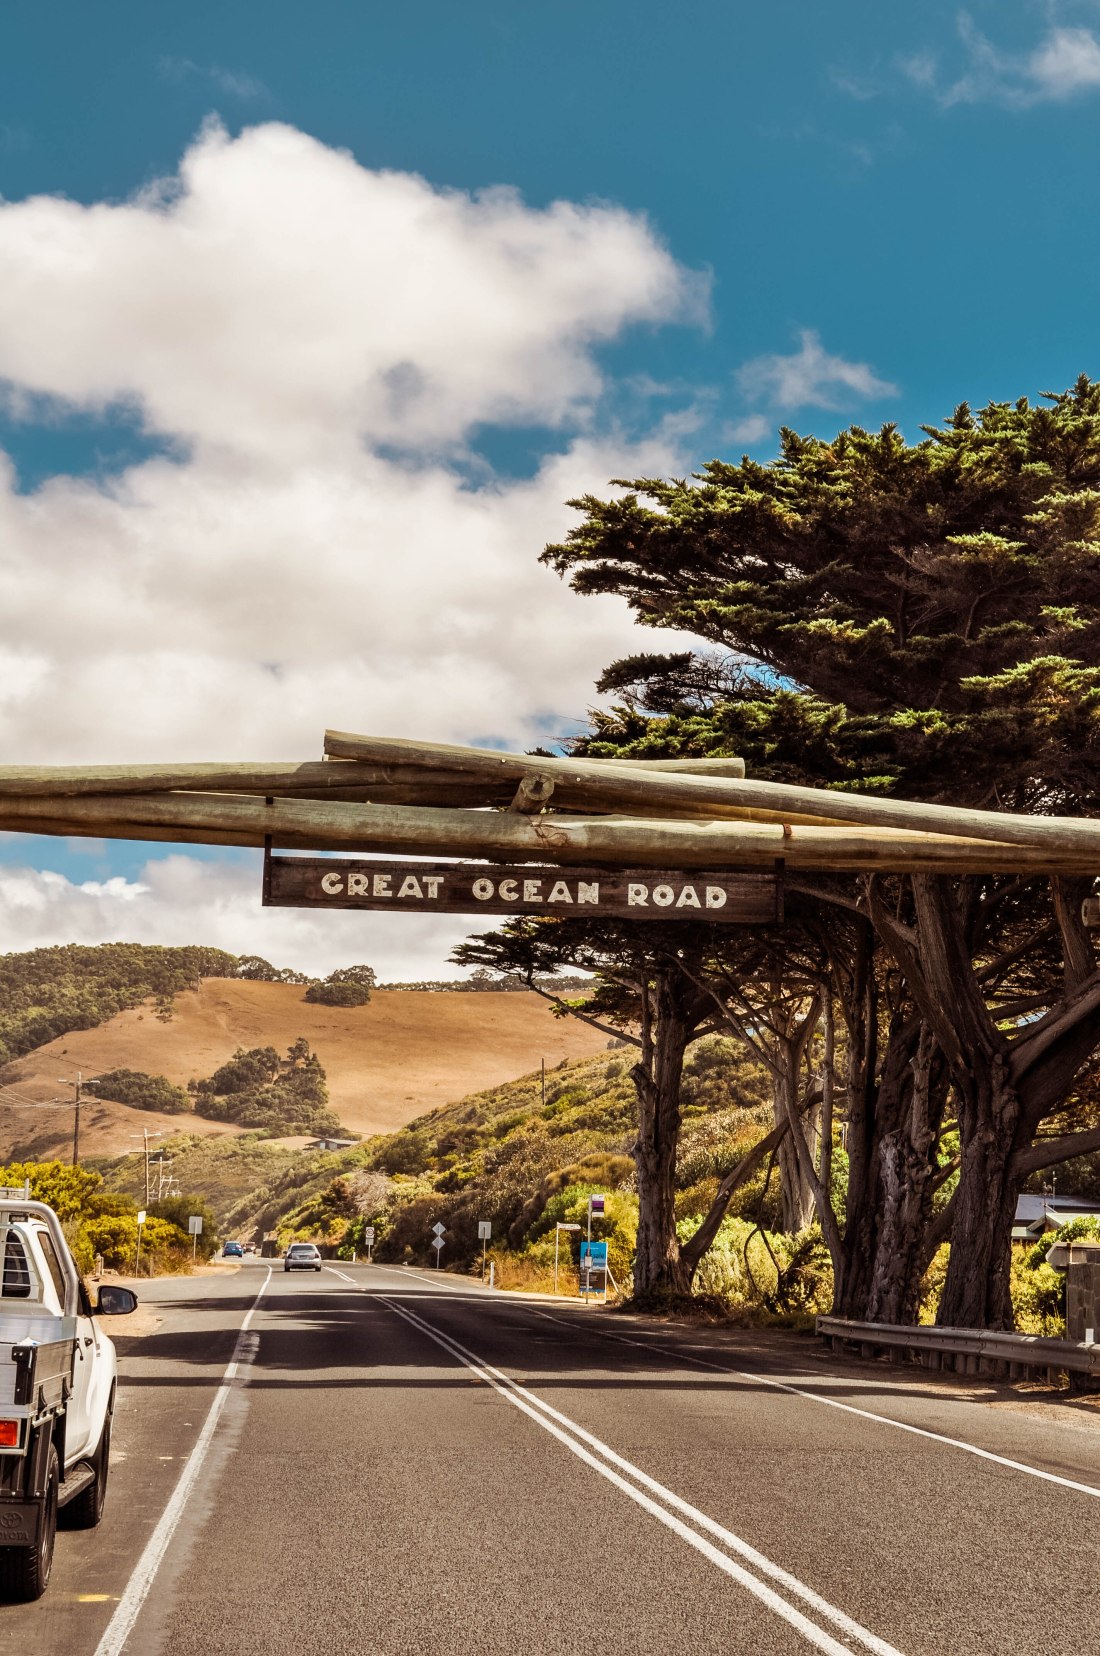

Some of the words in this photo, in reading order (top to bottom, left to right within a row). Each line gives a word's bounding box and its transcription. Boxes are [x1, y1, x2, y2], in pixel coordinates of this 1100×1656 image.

[321, 872, 445, 899] GREAT
[472, 878, 600, 905] OCEAN
[627, 883, 728, 909] ROAD
